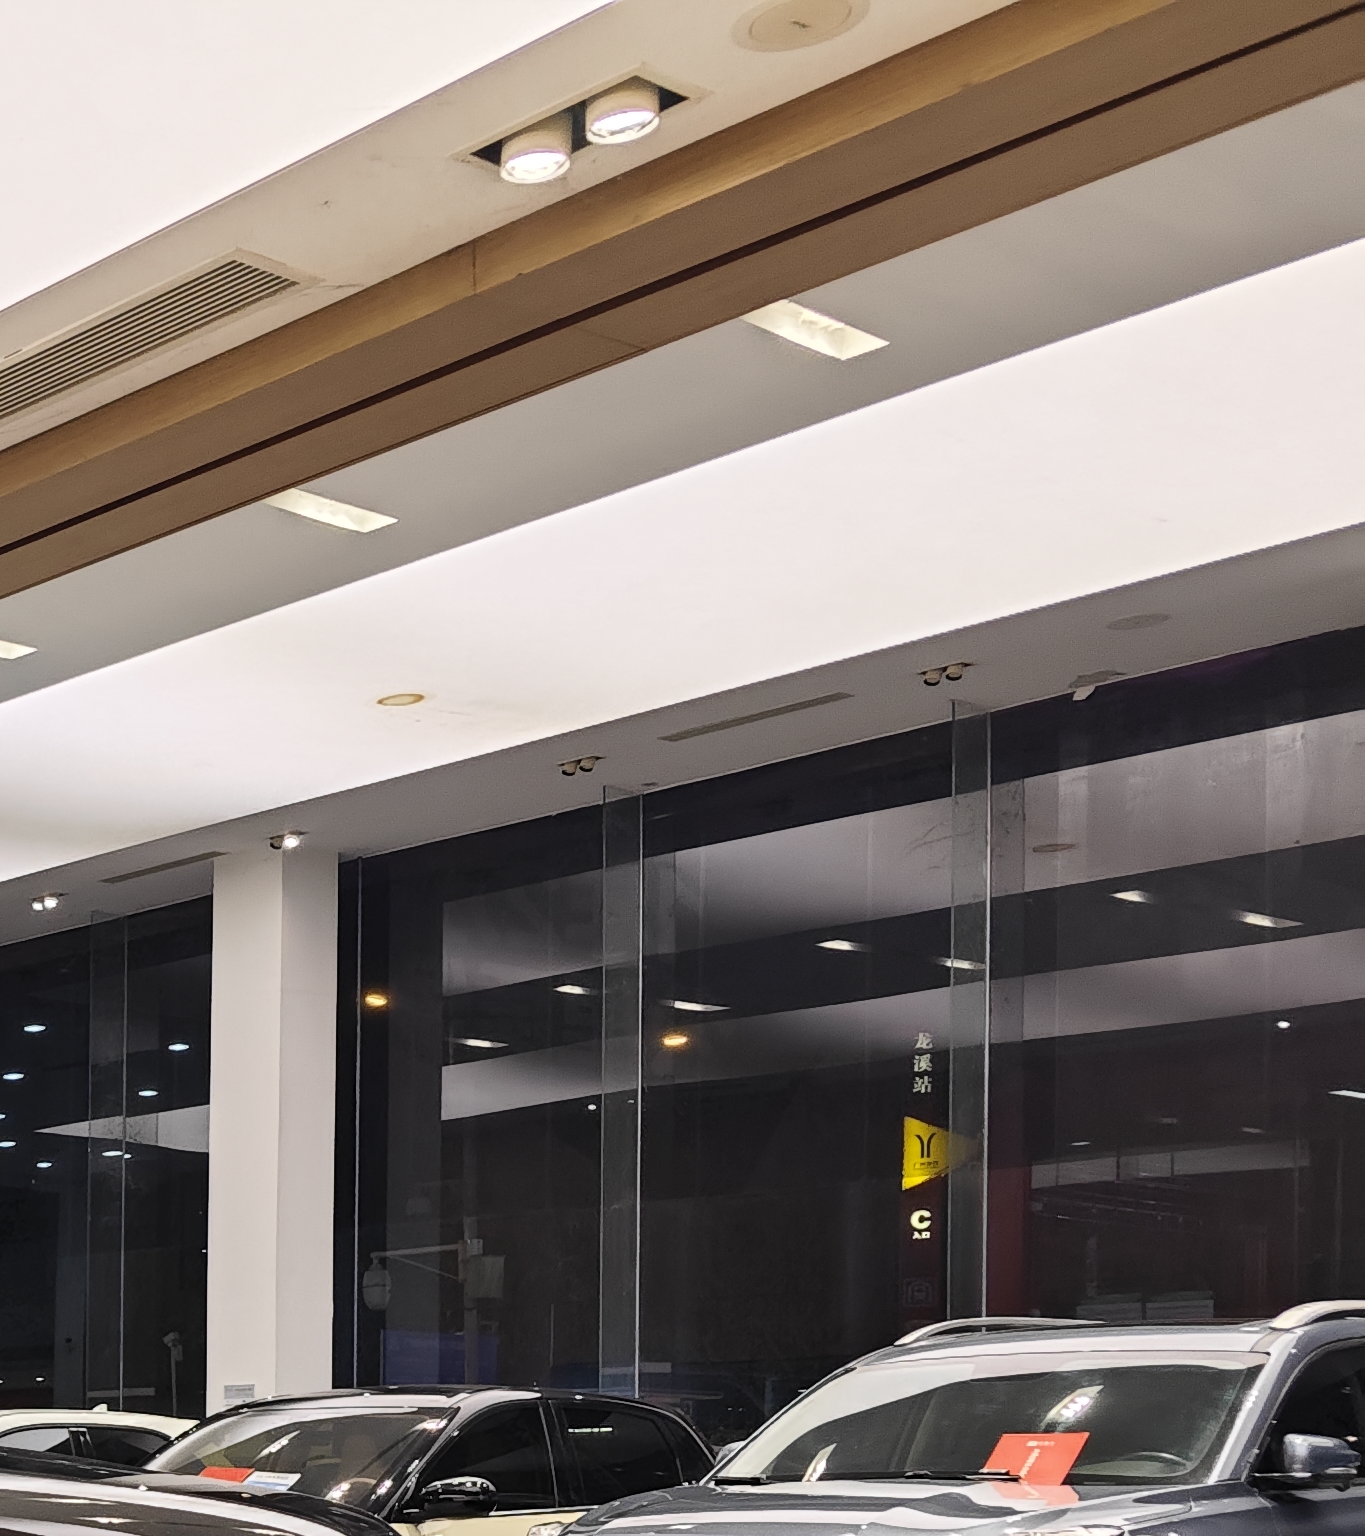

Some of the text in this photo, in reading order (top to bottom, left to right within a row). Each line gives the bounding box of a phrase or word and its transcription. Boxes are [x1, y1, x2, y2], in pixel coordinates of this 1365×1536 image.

[912, 1032, 933, 1093] 龙溪站
[910, 1209, 931, 1229] C
